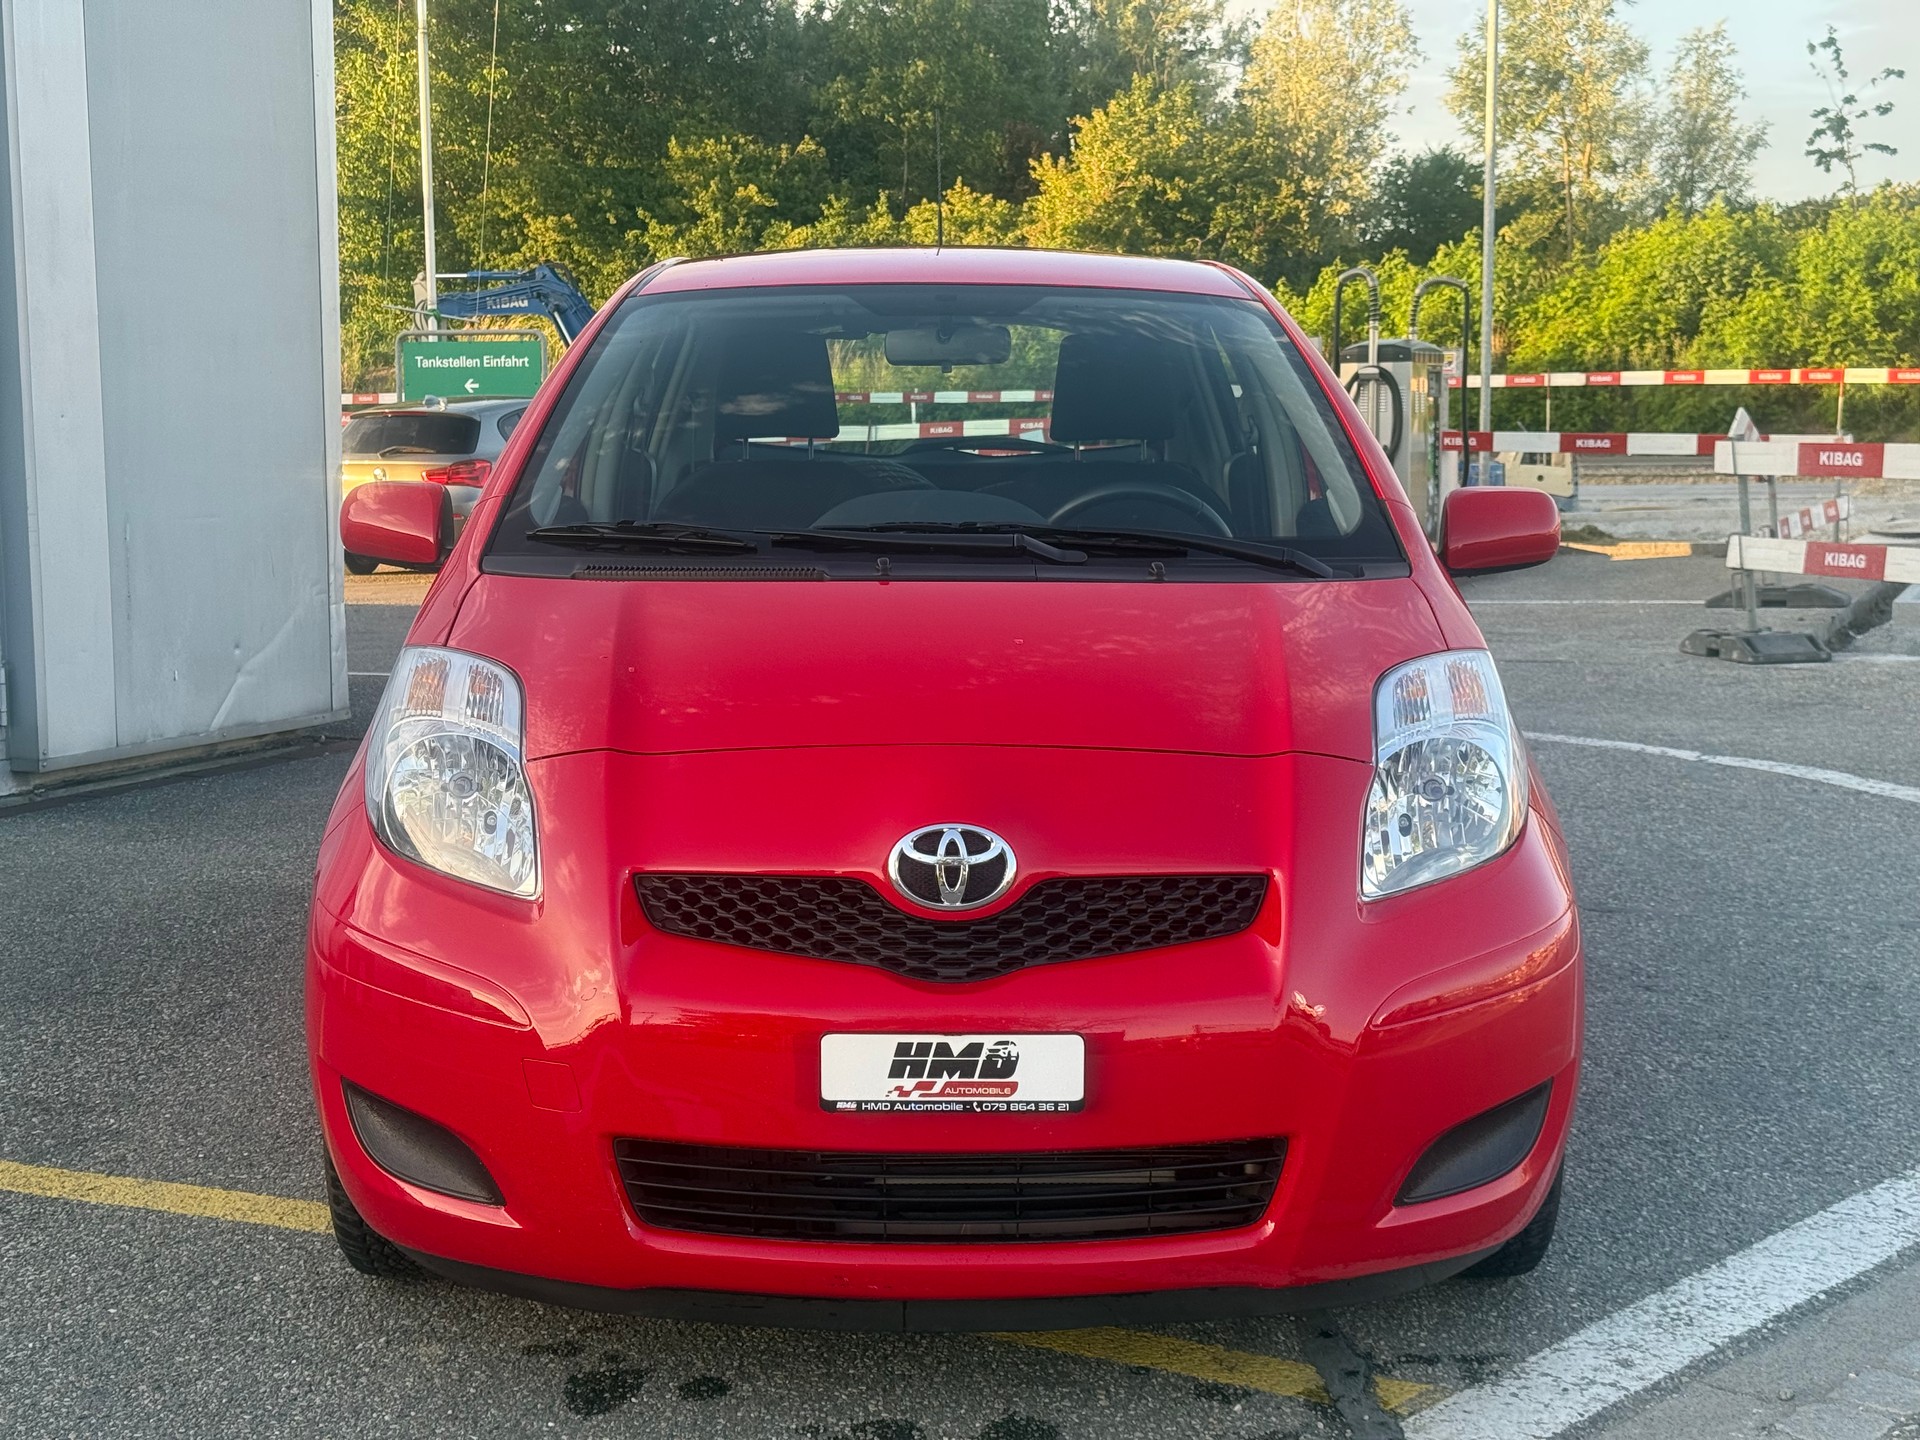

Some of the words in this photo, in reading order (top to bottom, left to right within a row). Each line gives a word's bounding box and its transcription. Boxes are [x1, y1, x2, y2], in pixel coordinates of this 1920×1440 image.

[486, 296, 529, 309] KIBAG
[415, 356, 480, 368] Tankstellen
[483, 355, 529, 368] Einfahrt
[1443, 437, 1477, 447] KIBG
[1576, 439, 1611, 448] KIBAG
[1819, 451, 1863, 466] KIBAG
[1824, 552, 1867, 568] KIBAG
[944, 1087, 1012, 1096] AUTOMOBILE
[862, 1102, 891, 1111] HMD
[894, 1102, 964, 1111] Automobile
[983, 1103, 1009, 1111] 079
[1010, 1103, 1037, 1111] 864
[1038, 1103, 1054, 1111] 36
[1056, 1103, 1069, 1111] 21
